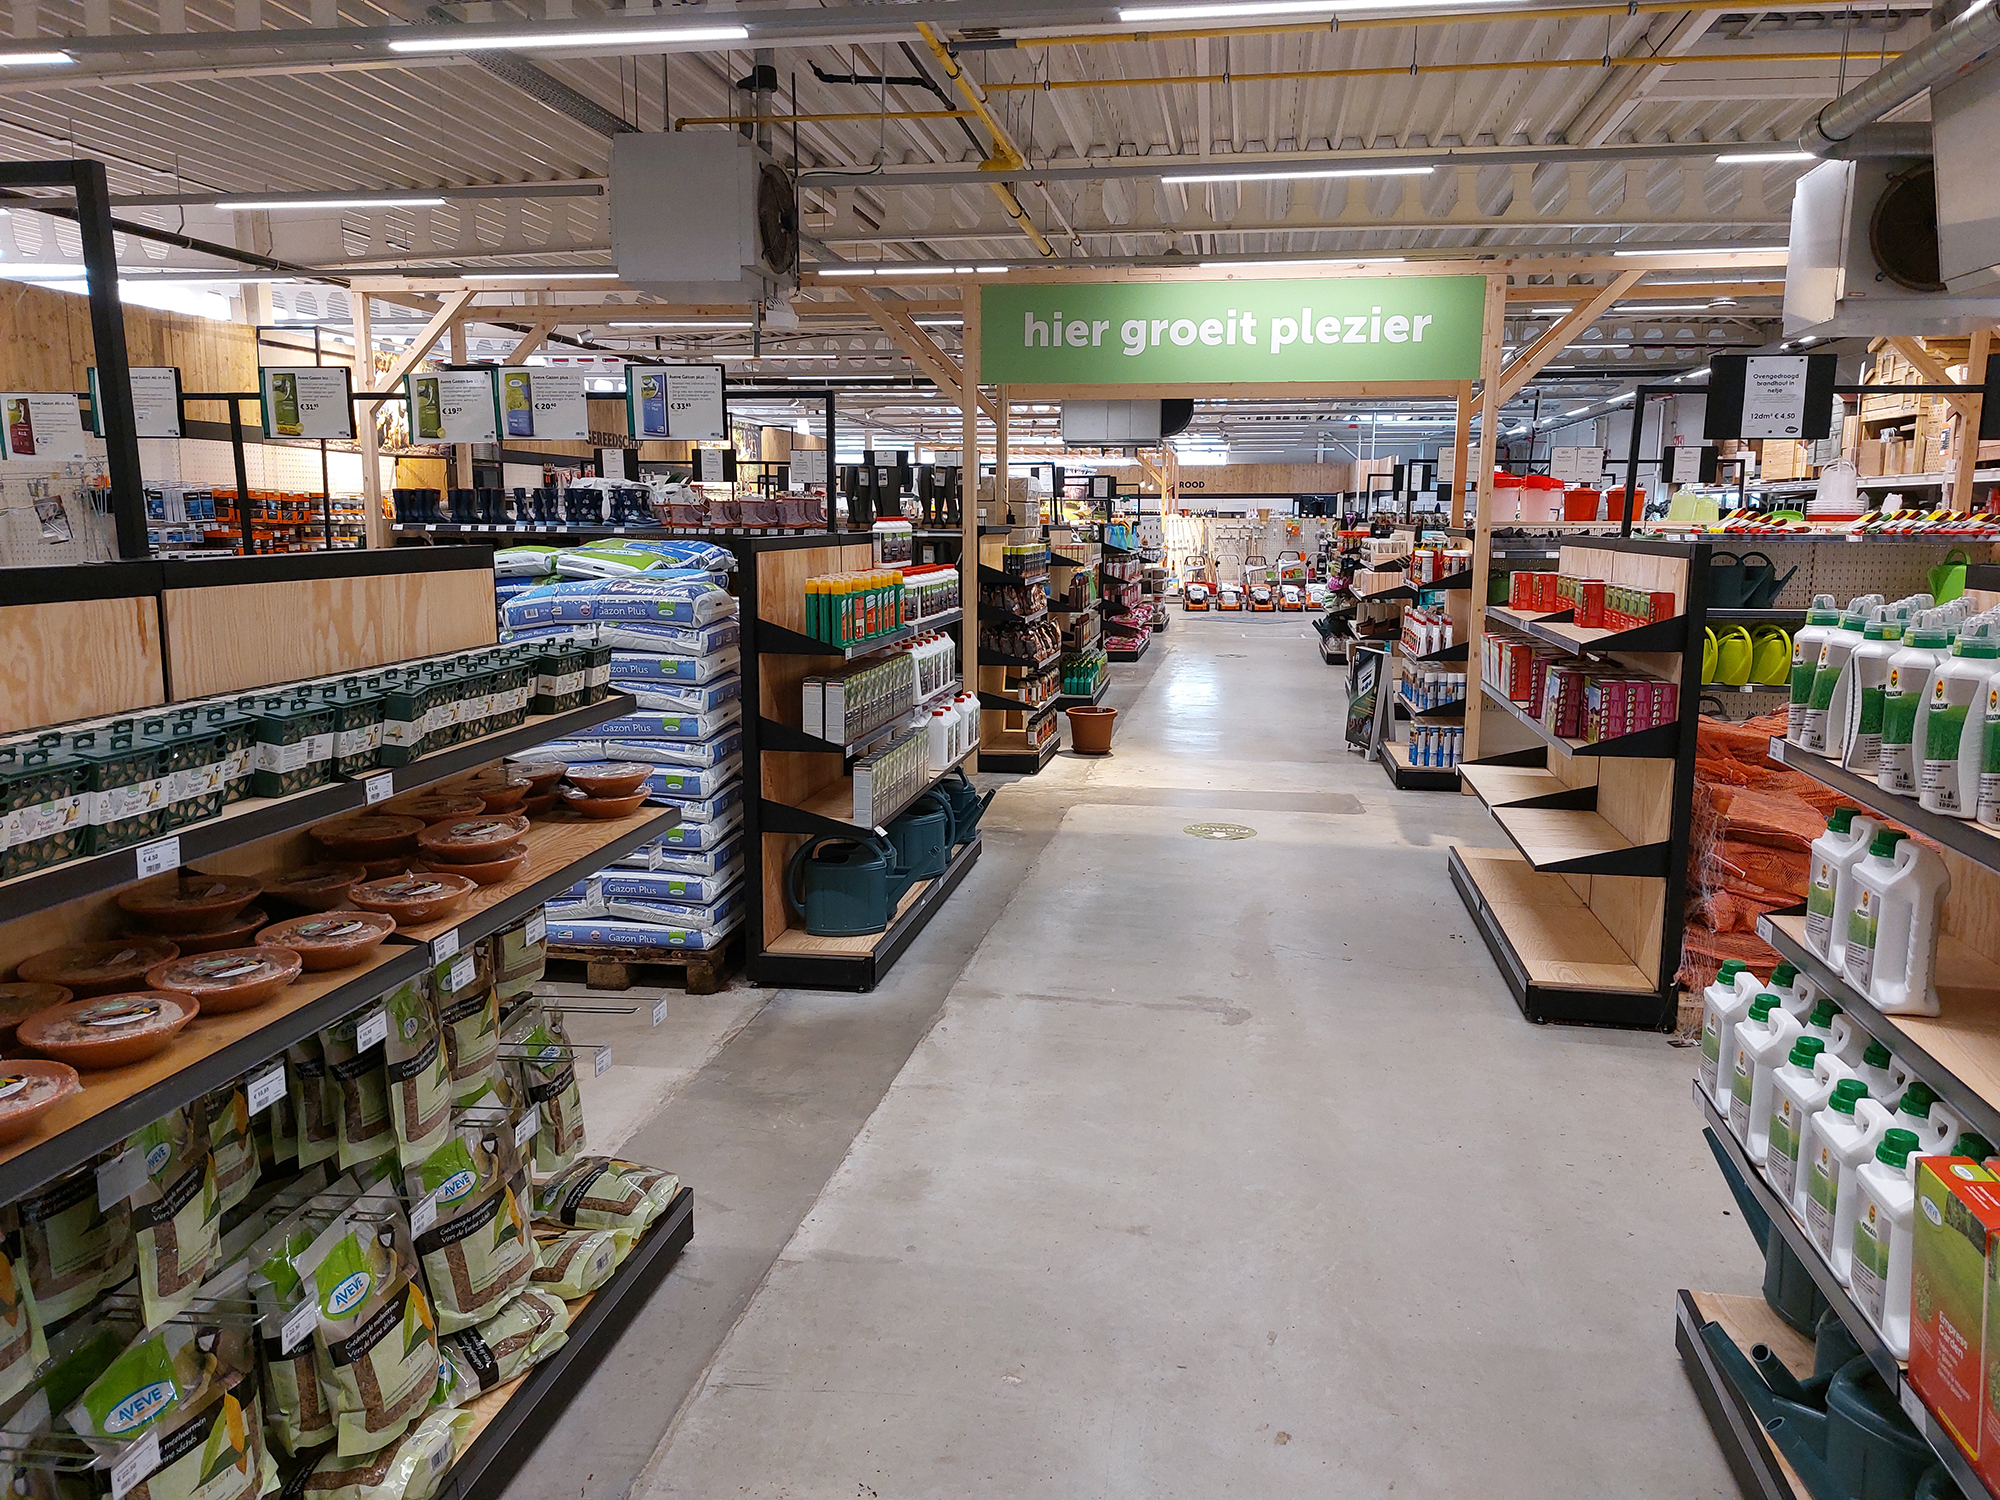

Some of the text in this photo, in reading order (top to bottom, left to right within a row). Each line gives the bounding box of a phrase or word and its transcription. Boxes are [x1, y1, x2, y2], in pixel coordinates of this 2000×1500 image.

[1023, 305, 1434, 357] hier groeit plezier
[587, 430, 644, 450] GEREEDSCHAP
[628, 606, 646, 615] Plus
[629, 665, 648, 673] Plus
[602, 724, 652, 732] Gazon Plus
[608, 884, 657, 894] Gazon Plus
[608, 933, 657, 944] Gazon Plus
[444, 1174, 470, 1196] AVEVE
[440, 1216, 471, 1236] Gedroogde
[441, 1233, 456, 1244] Vers
[335, 1276, 364, 1306] AVEVE
[345, 1300, 399, 1350] Gedroogde meelwormen
[1940, 1310, 1968, 1350] Empress
[347, 1346, 364, 1358] Vers
[1938, 1324, 1964, 1360] Garden
[118, 1388, 162, 1421] AVEVE
[164, 1417, 207, 1450] meelwormen
[176, 1434, 198, 1456] séchés
